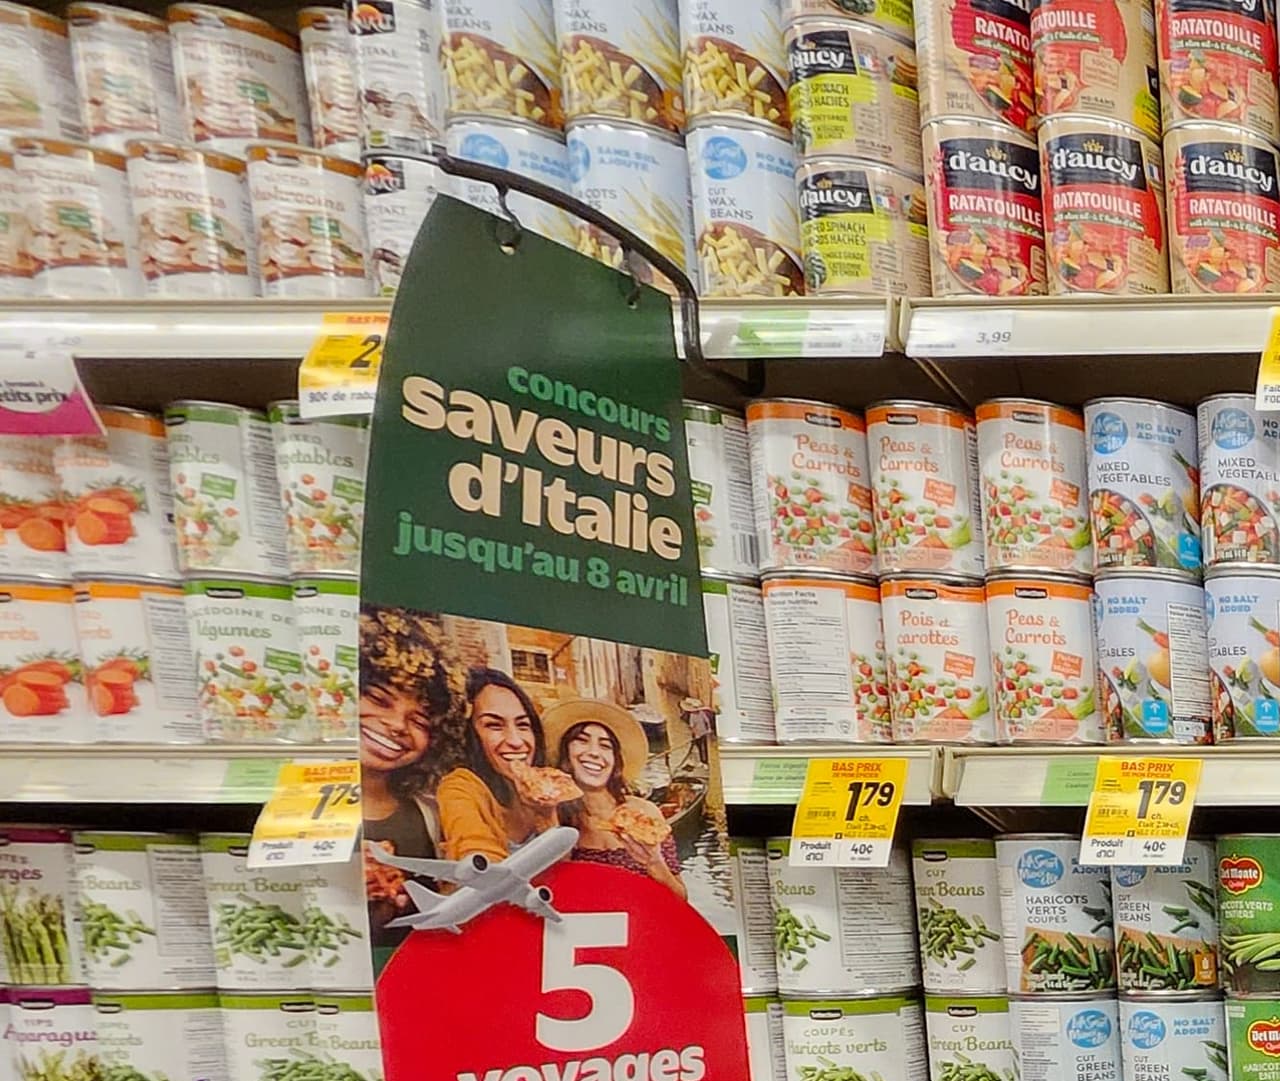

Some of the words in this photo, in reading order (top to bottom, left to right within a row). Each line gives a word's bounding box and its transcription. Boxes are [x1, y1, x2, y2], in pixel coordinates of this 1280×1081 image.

[950, 151, 1038, 189] d'aucy
[1053, 149, 1139, 181] d'aucy
[1191, 155, 1272, 191] d'aucy
[949, 194, 1042, 228] RATATOUILLE
[1053, 191, 1142, 219] RATATOUILLE
[1189, 200, 1276, 228] RATATOUILLE
[507, 366, 671, 442] concours
[402, 375, 676, 497] saveurs
[879, 436, 916, 454] Peas
[879, 457, 939, 474] Carrots
[1096, 461, 1129, 471] MIXED
[1218, 458, 1256, 468] MIXED
[1097, 474, 1171, 486] VEGETABLES
[449, 454, 683, 560] d'Italie
[394, 511, 579, 582] jusqu'au
[587, 558, 610, 590] 8
[617, 569, 688, 606] avril
[901, 610, 935, 627] Pois
[1007, 609, 1044, 627] Peas
[898, 632, 959, 646] carottes
[1005, 630, 1066, 646] Carrots
[832, 762, 854, 772] BAS
[857, 762, 882, 773] PRIX
[1121, 762, 1143, 772] BAS
[1146, 762, 1175, 772] PRIX
[800, 841, 831, 851] Produit
[851, 843, 873, 855] 40¢
[1091, 838, 1124, 848] Produit
[1143, 841, 1166, 853] 40¢
[1026, 895, 1089, 905] HARICOTS
[1026, 906, 1065, 915] VERTS
[535, 912, 635, 1052] 5
[1250, 1029, 1271, 1042] Del
[1076, 1056, 1096, 1064] CUT
[1076, 1064, 1115, 1072] GREEN
[1077, 1071, 1116, 1081] BEANS
